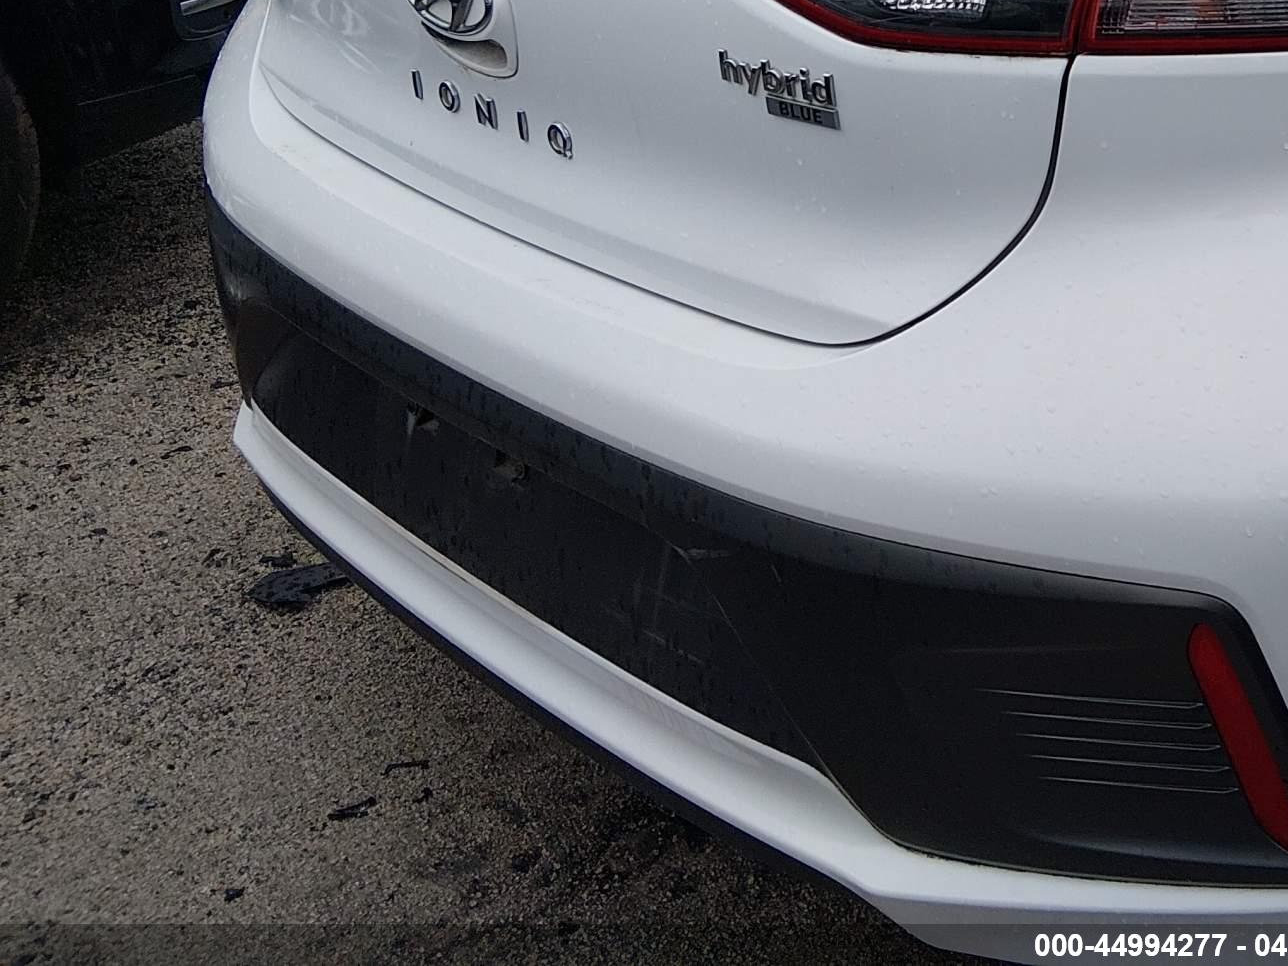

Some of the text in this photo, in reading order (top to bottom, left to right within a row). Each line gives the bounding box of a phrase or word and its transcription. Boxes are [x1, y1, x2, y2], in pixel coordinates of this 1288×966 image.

[718, 48, 837, 107] hybrid
[411, 68, 573, 160] IONIQ
[779, 103, 823, 123] BLUE
